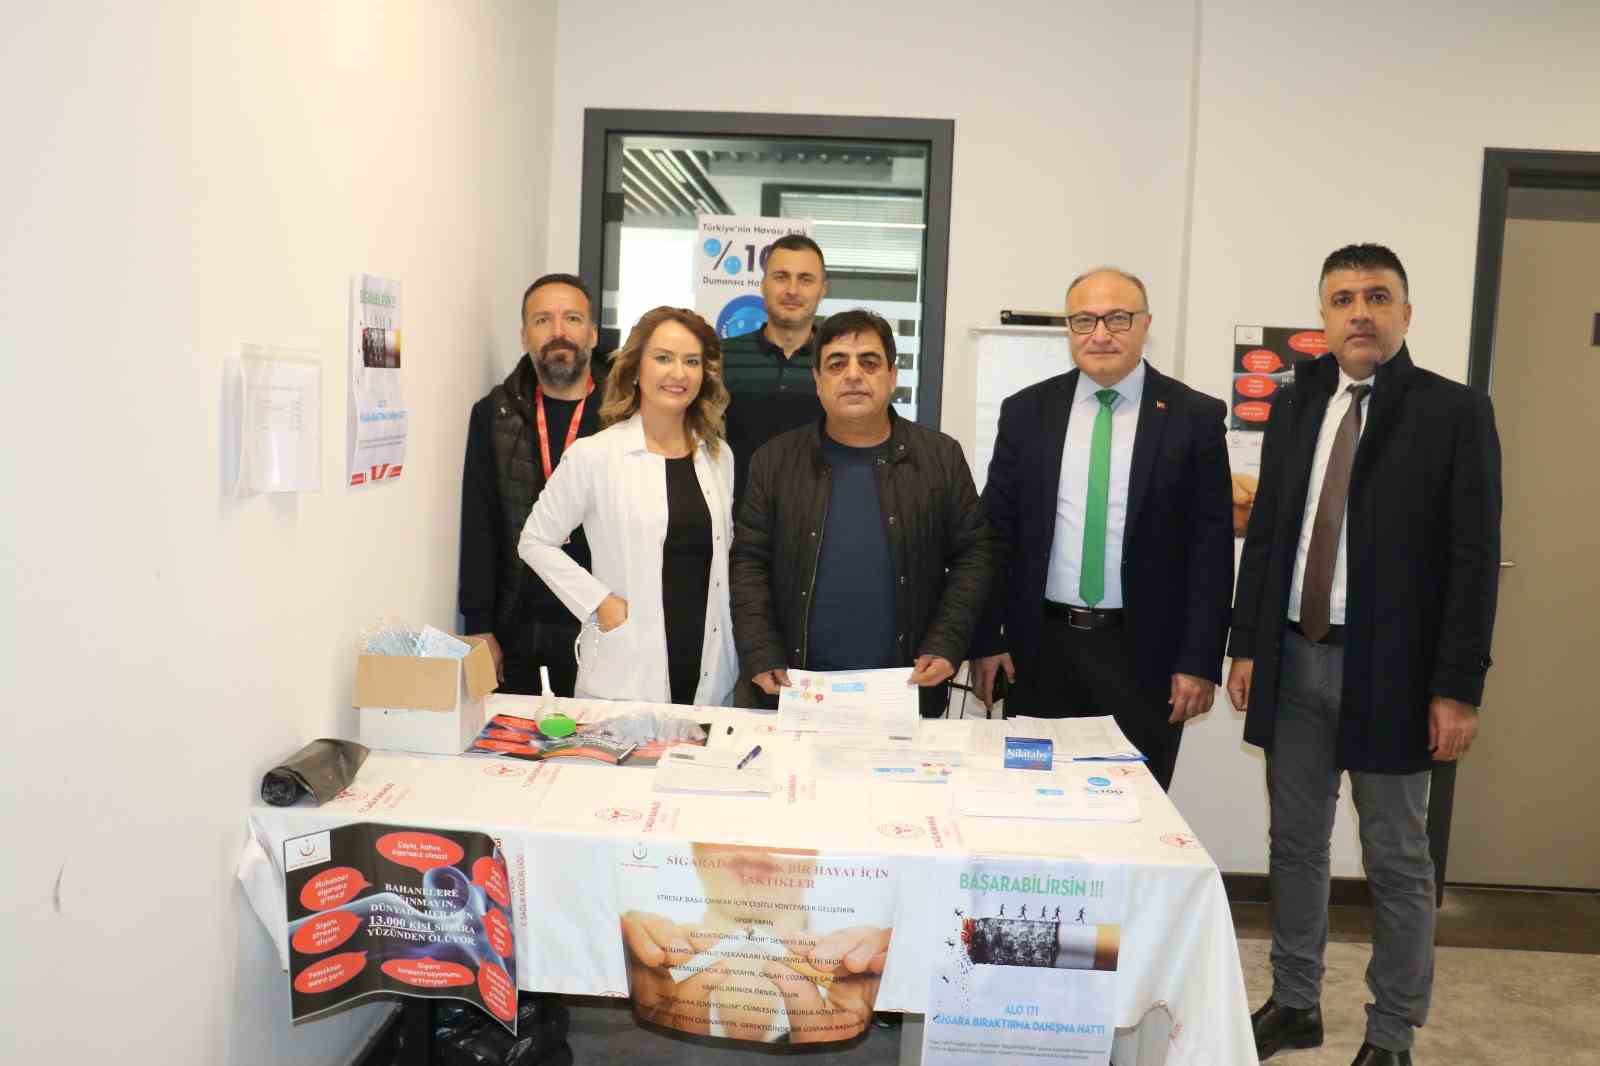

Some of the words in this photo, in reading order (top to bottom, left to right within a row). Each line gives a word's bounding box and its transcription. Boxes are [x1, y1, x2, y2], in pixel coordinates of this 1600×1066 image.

[815, 866, 857, 878] HAYAT
[860, 865, 889, 881] İÇİN
[385, 883, 459, 897] BAHANELERE
[959, 872, 1086, 898] BAŞARABİLİRSİN
[370, 915, 406, 928] 13.000
[368, 927, 426, 941] YÜZÜNDEN
